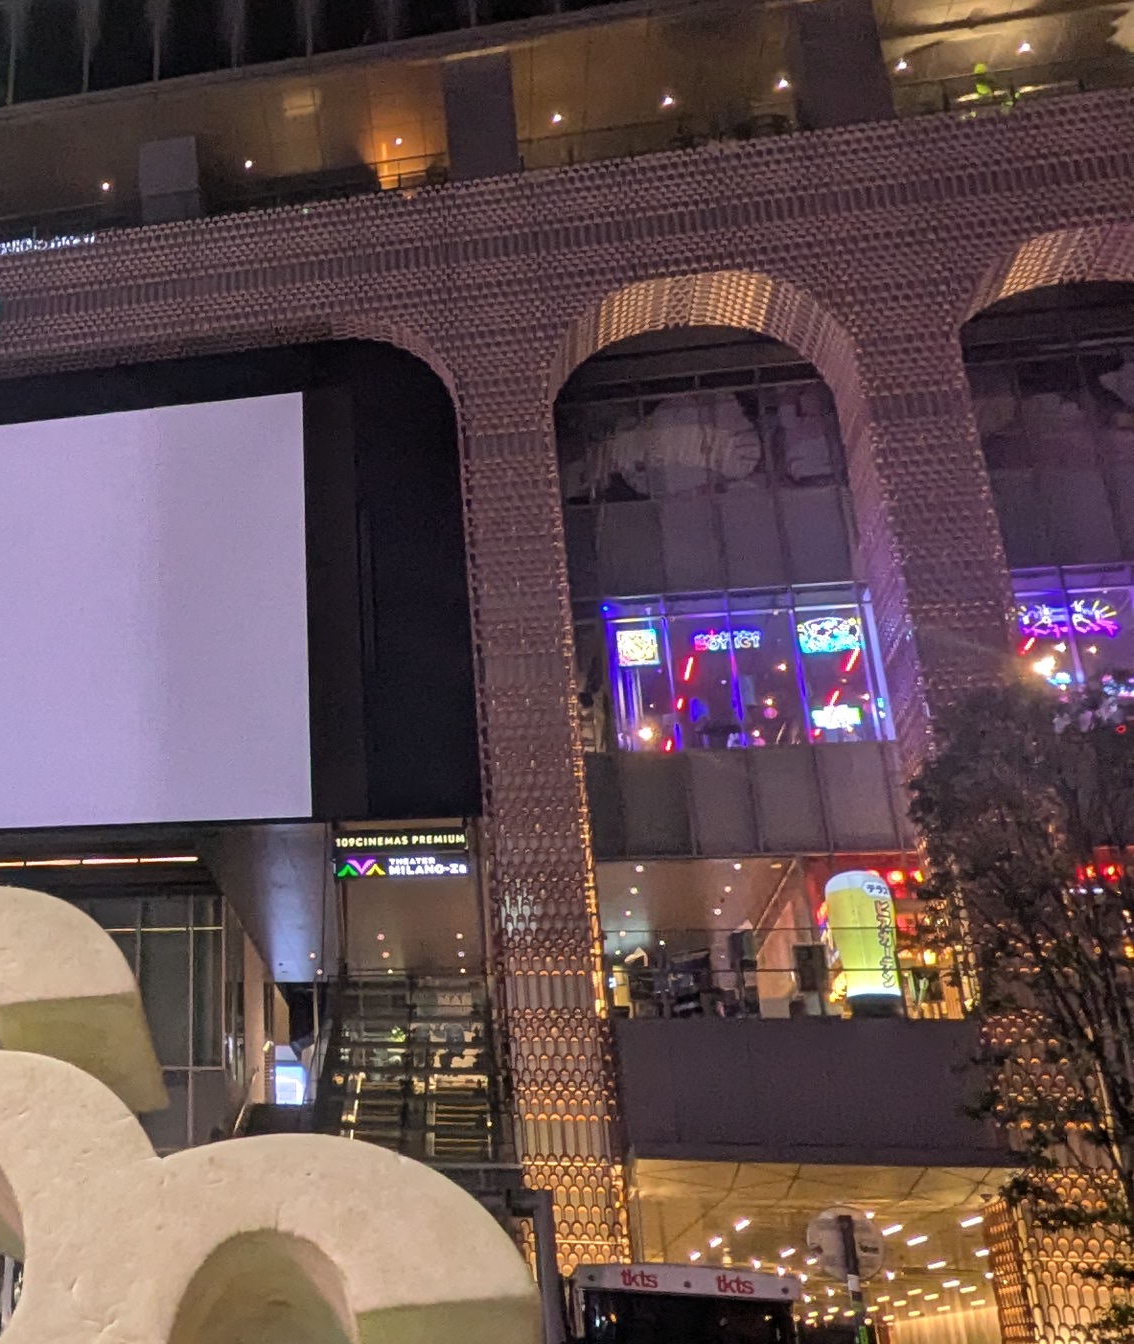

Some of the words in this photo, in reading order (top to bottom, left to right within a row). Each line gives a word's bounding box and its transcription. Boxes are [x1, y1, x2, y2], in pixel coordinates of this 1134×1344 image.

[335, 836, 408, 848] 109CINEMAS
[412, 834, 465, 845] PREMIUM
[620, 1269, 658, 1288] tkts
[717, 1274, 755, 1295] tkts
